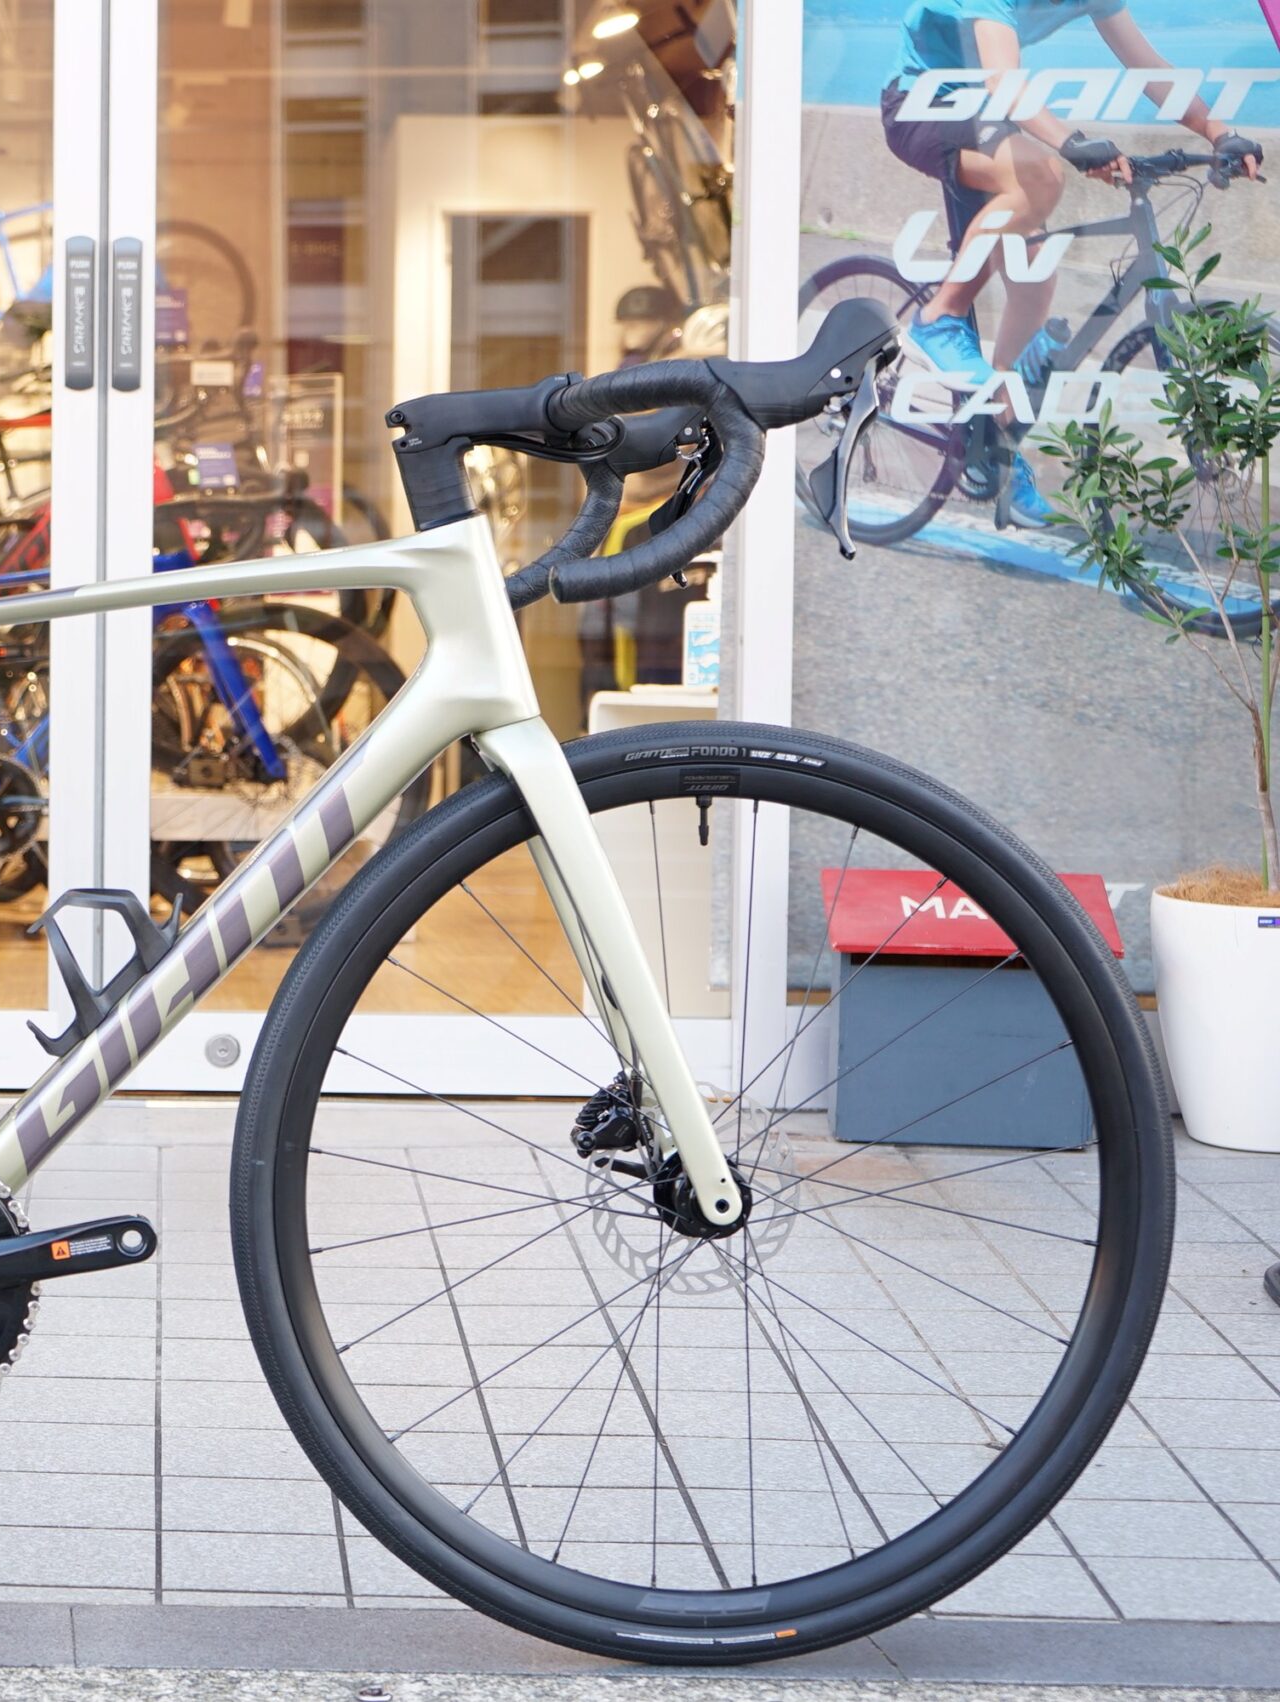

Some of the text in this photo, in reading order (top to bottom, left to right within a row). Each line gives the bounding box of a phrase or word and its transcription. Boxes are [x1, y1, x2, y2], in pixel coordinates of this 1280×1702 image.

[894, 68, 1280, 122] GIANT
[891, 210, 1076, 284] Liv
[891, 371, 1190, 424] CADE
